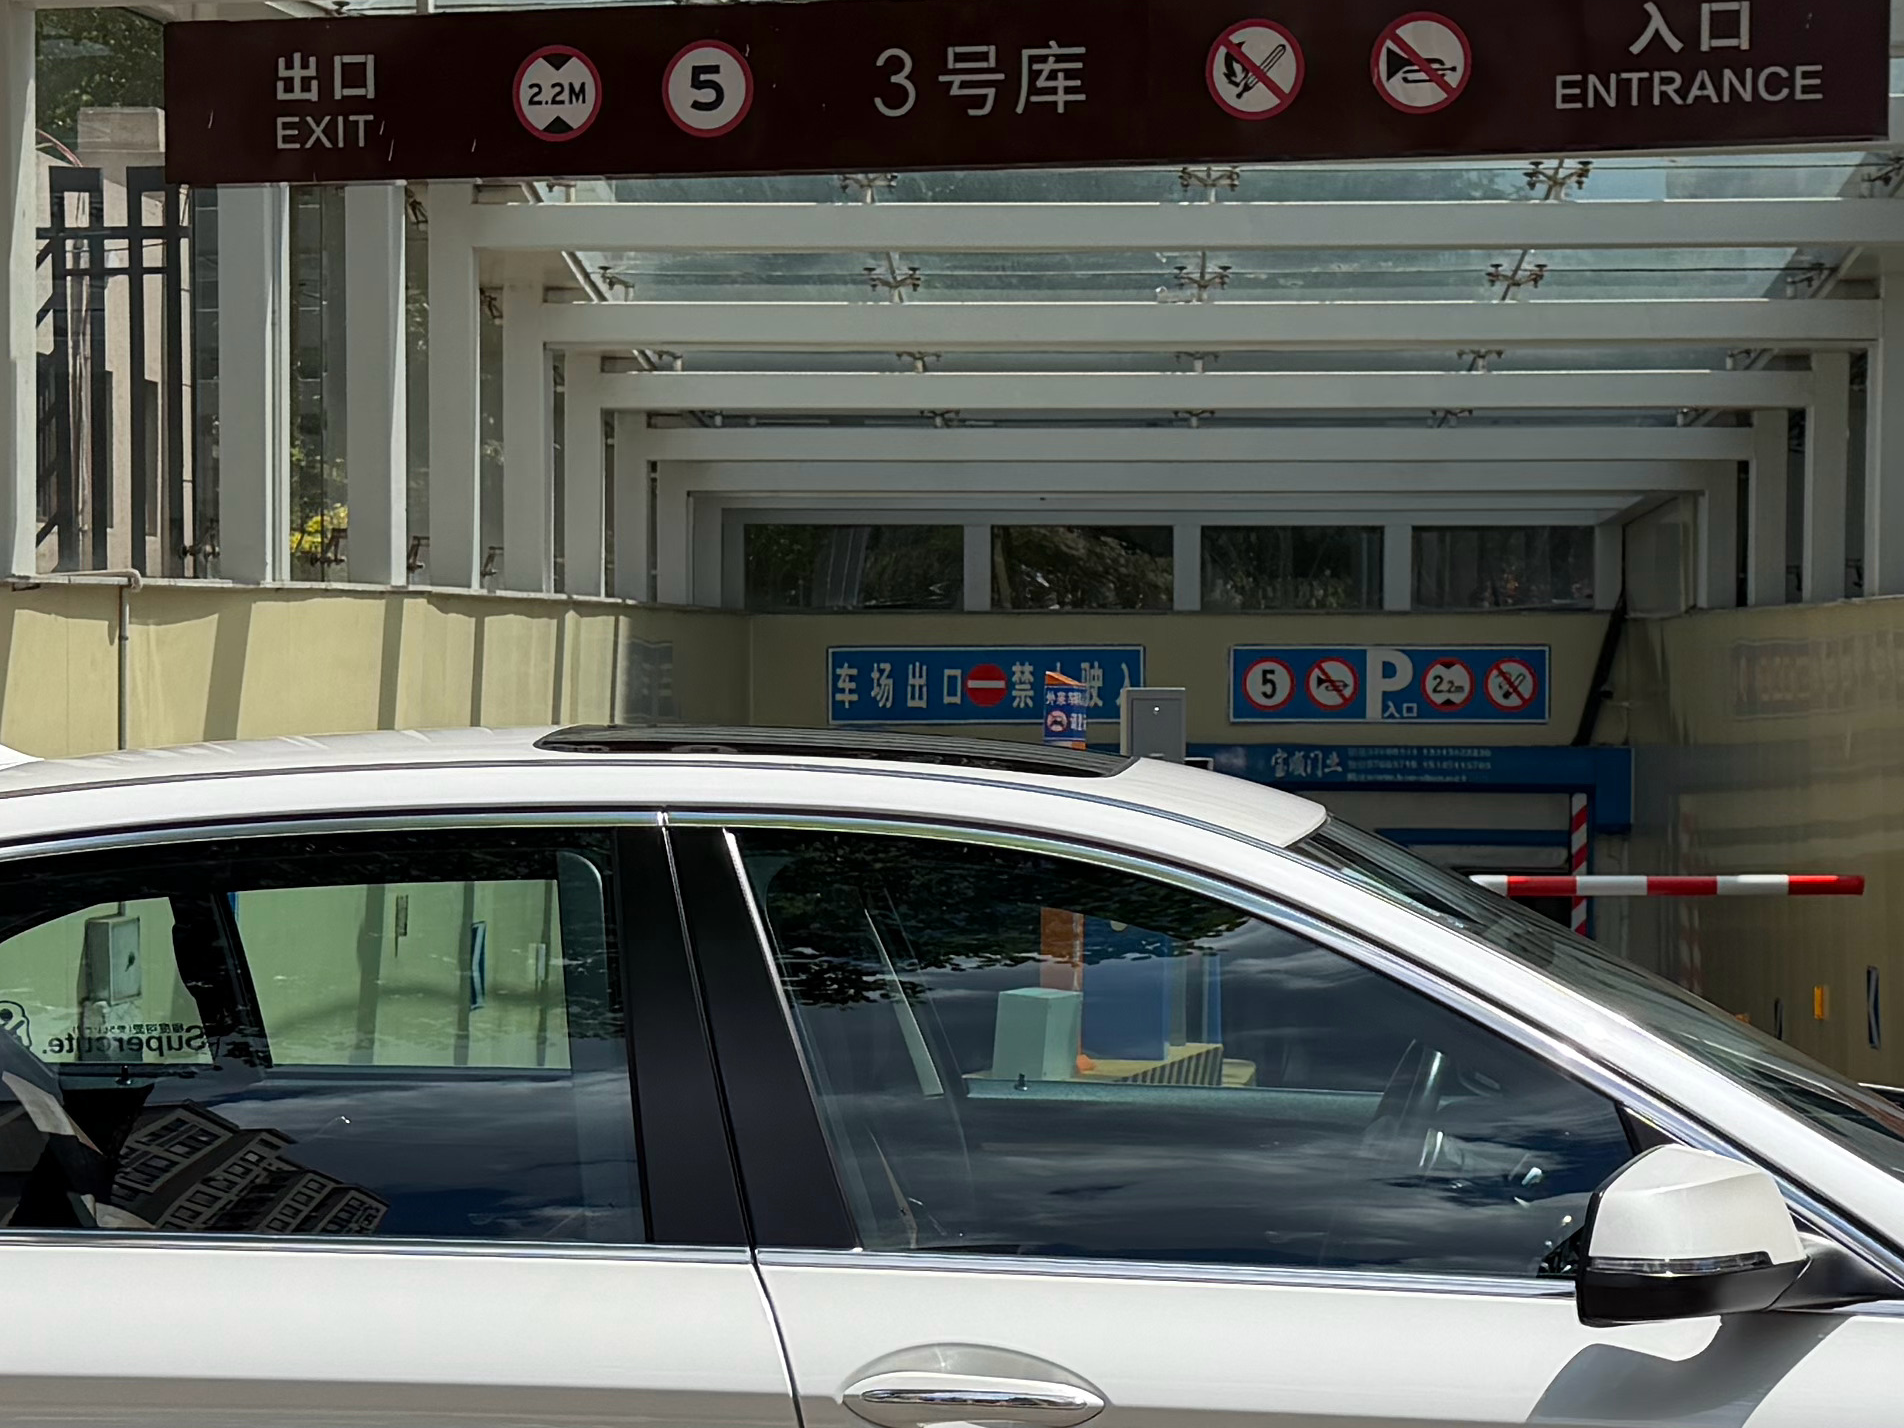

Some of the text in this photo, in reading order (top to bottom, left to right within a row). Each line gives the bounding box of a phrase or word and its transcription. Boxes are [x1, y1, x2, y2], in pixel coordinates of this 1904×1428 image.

[1628, 0, 1752, 56] 入口
[276, 50, 376, 103] 出口
[527, 80, 588, 107] 2.2M
[689, 63, 726, 113] 5
[873, 41, 1088, 118] 3号库
[1554, 64, 1825, 112] ENTRANCE
[276, 115, 376, 150] EXIT
[834, 660, 963, 709] 车场出口
[1260, 669, 1277, 699] 5
[1366, 649, 1413, 719] P
[1383, 701, 1418, 719] 入口
